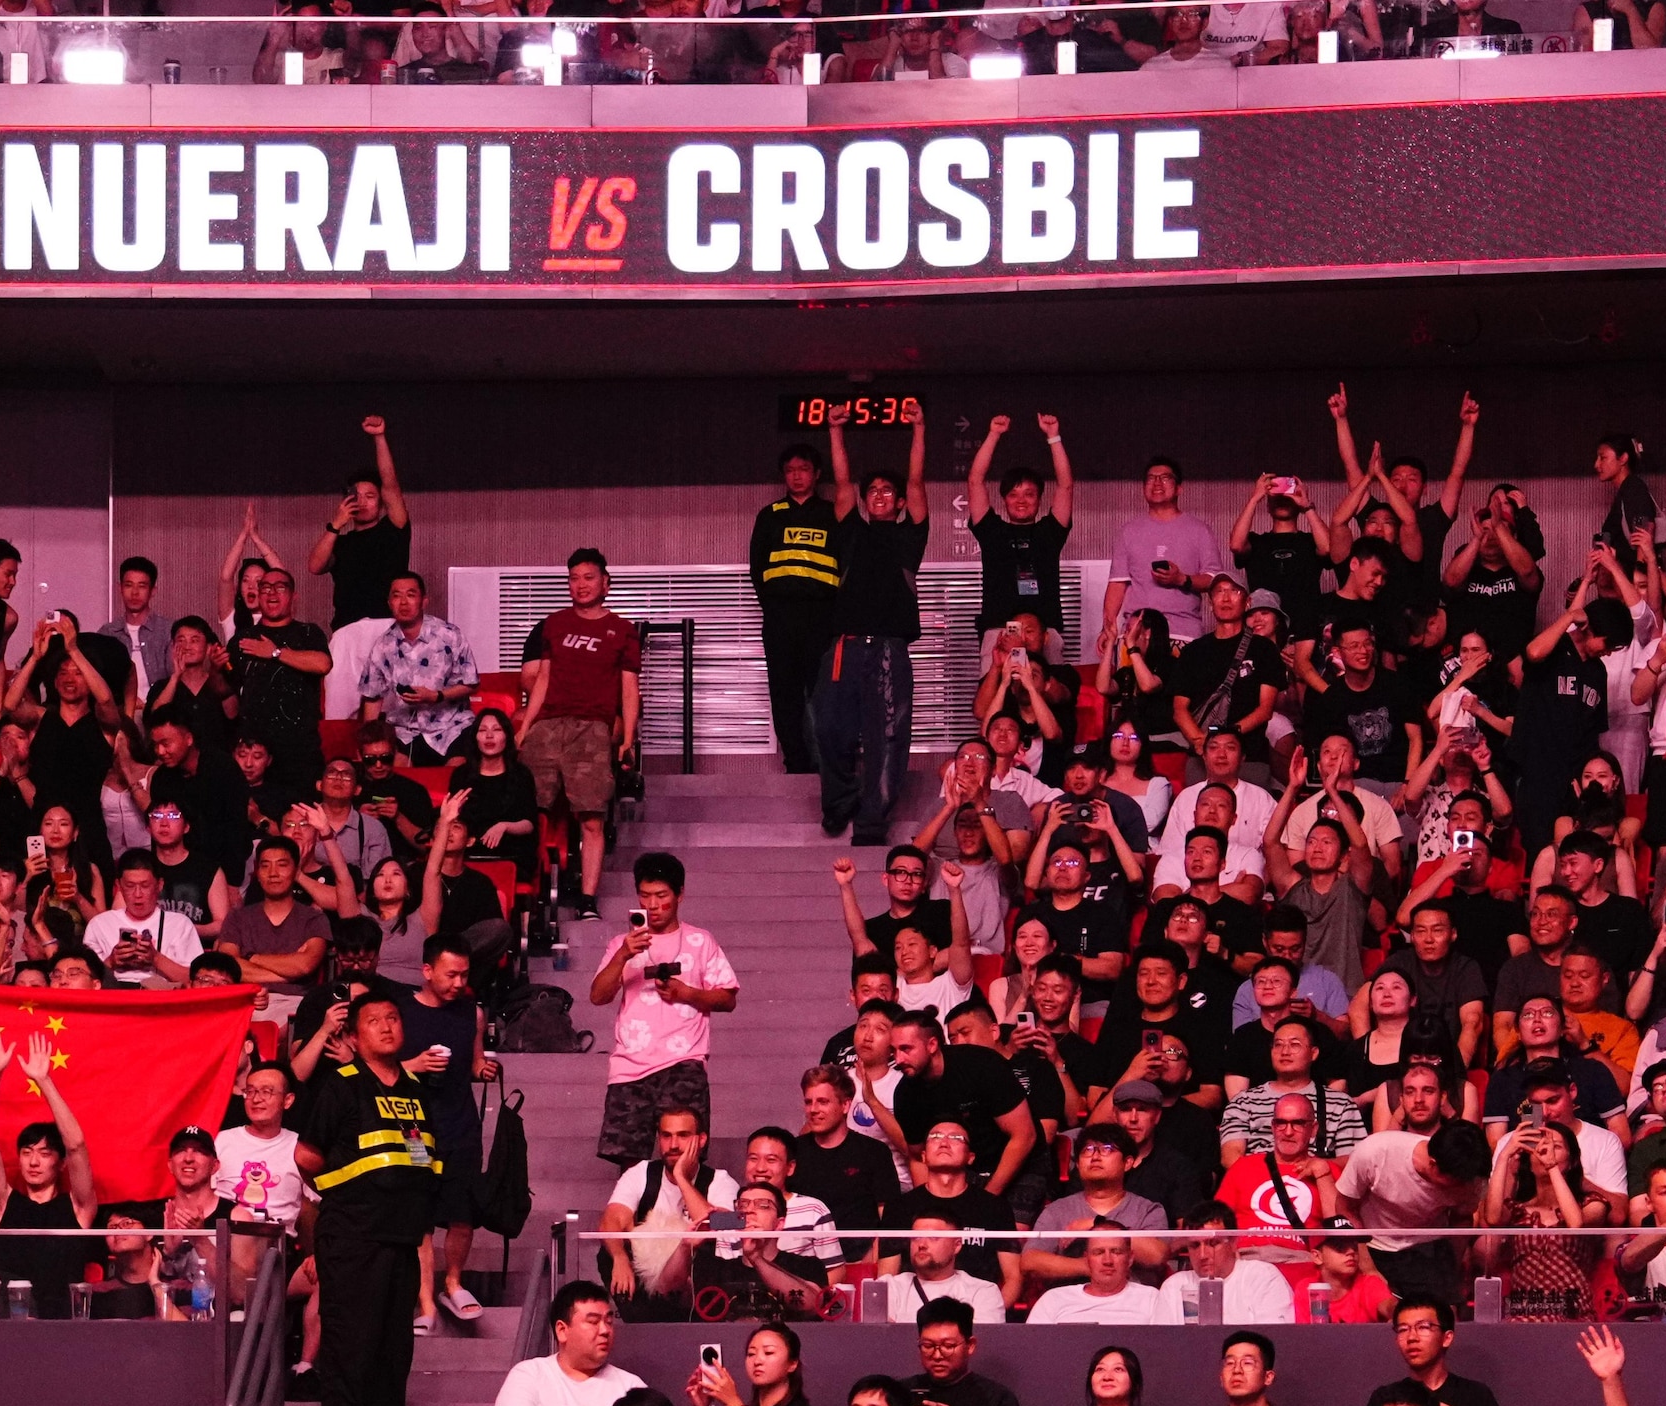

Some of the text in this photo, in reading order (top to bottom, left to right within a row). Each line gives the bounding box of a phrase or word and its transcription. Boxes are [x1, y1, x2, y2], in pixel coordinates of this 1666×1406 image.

[1205, 34, 1258, 44] SALOMON
[2, 129, 1200, 273] NUERAJI VS CROSBIE
[787, 530, 824, 542] VSP
[562, 634, 602, 652] UFC
[1082, 885, 1109, 902] FC
